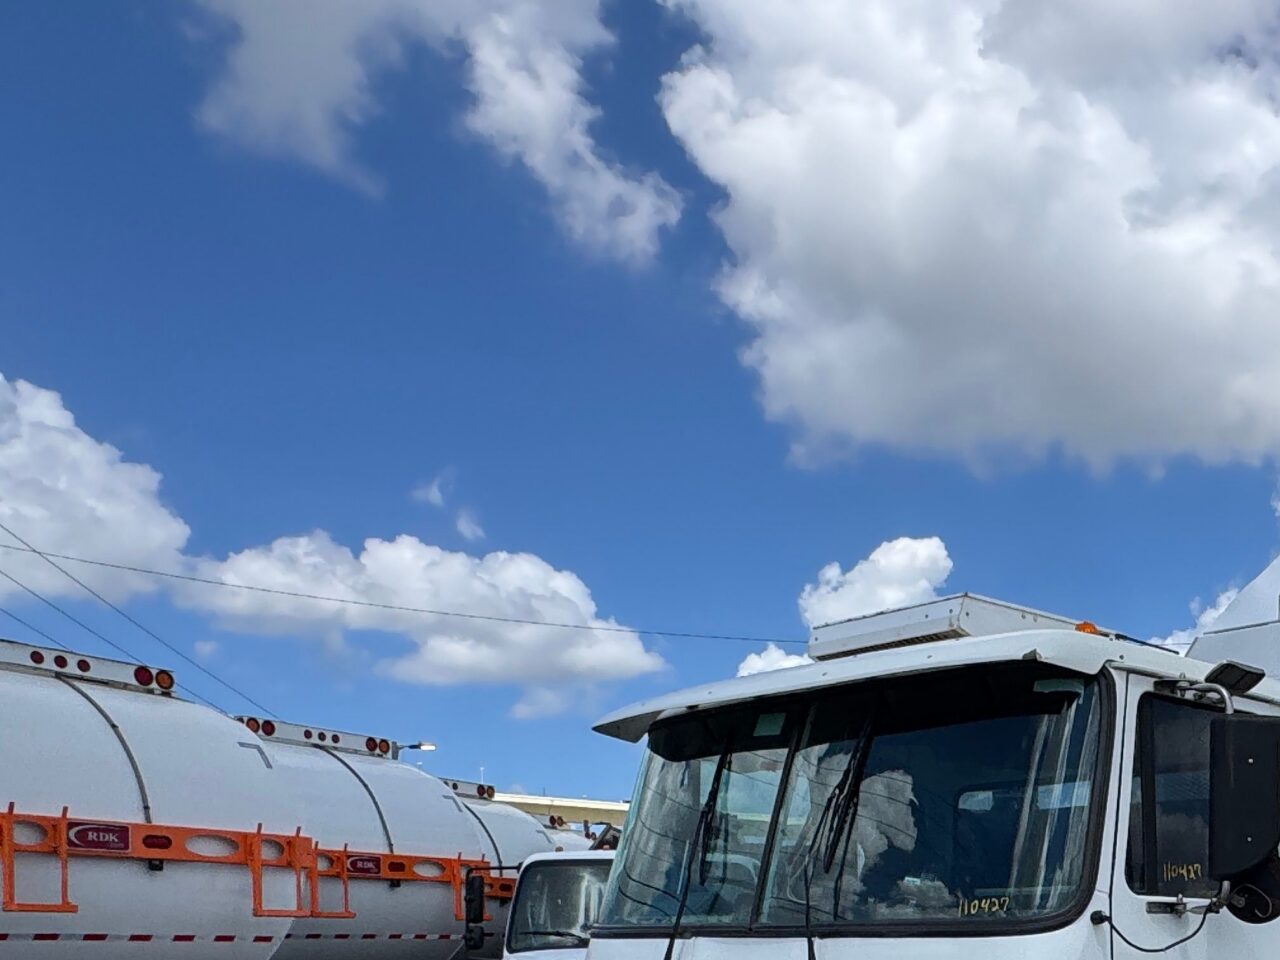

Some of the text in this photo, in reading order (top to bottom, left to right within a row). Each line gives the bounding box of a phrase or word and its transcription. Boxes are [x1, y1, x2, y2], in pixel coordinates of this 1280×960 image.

[87, 831, 118, 842] RDK
[357, 860, 376, 870] RDK
[1163, 861, 1202, 881] 110427
[958, 896, 1010, 917] 110427
